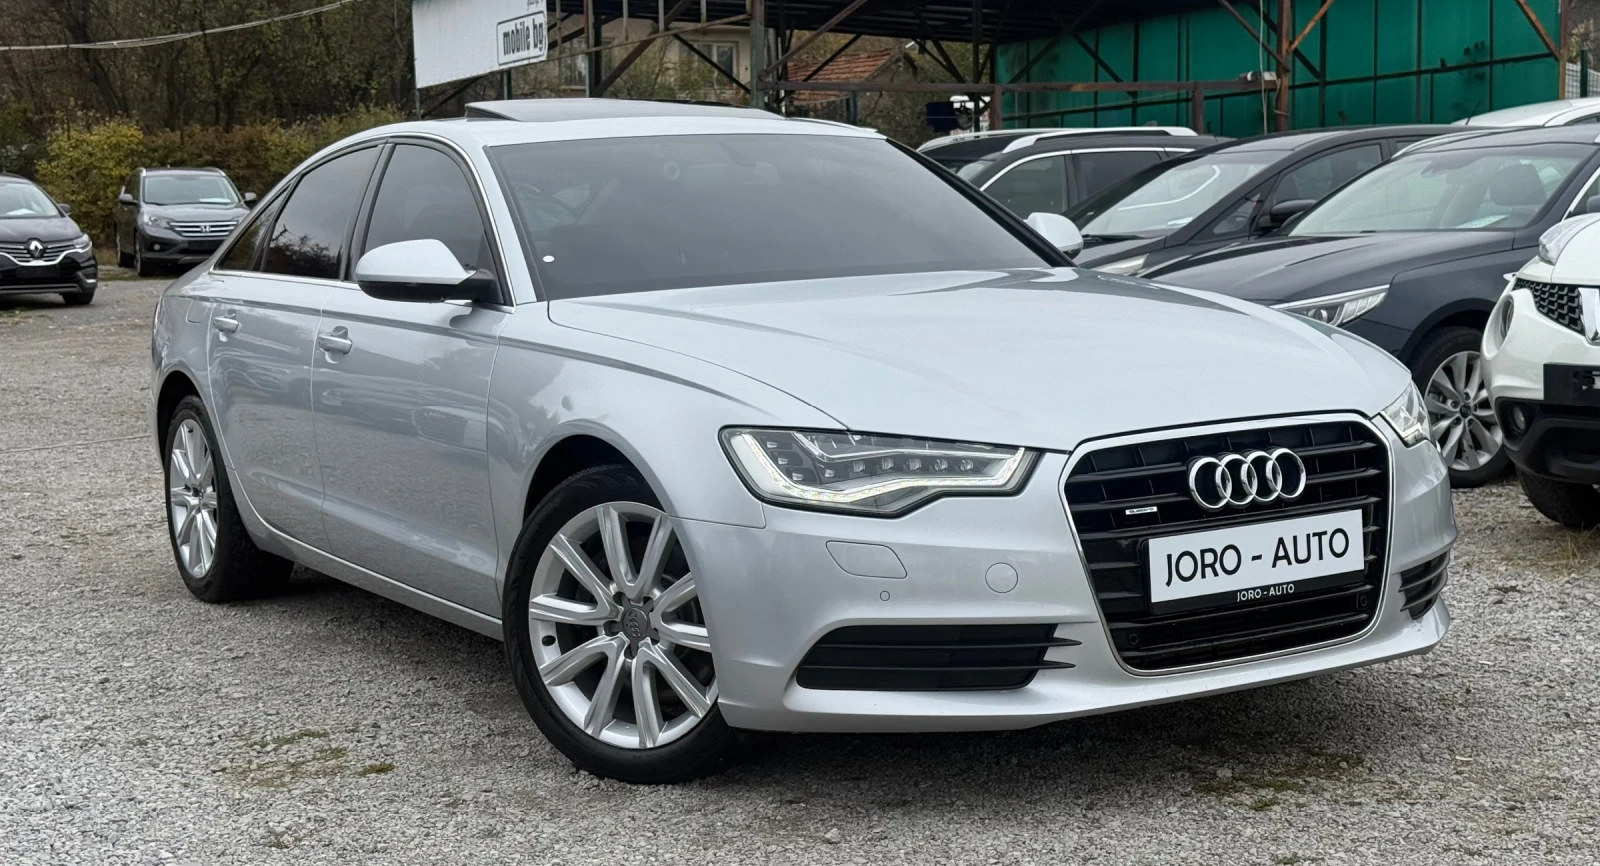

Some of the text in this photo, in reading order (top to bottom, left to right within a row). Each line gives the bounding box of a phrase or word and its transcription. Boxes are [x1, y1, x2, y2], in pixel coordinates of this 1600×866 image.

[503, 18, 544, 56] mobile bg
[1166, 543, 1242, 587] JORO
[1271, 527, 1350, 569] AUTO
